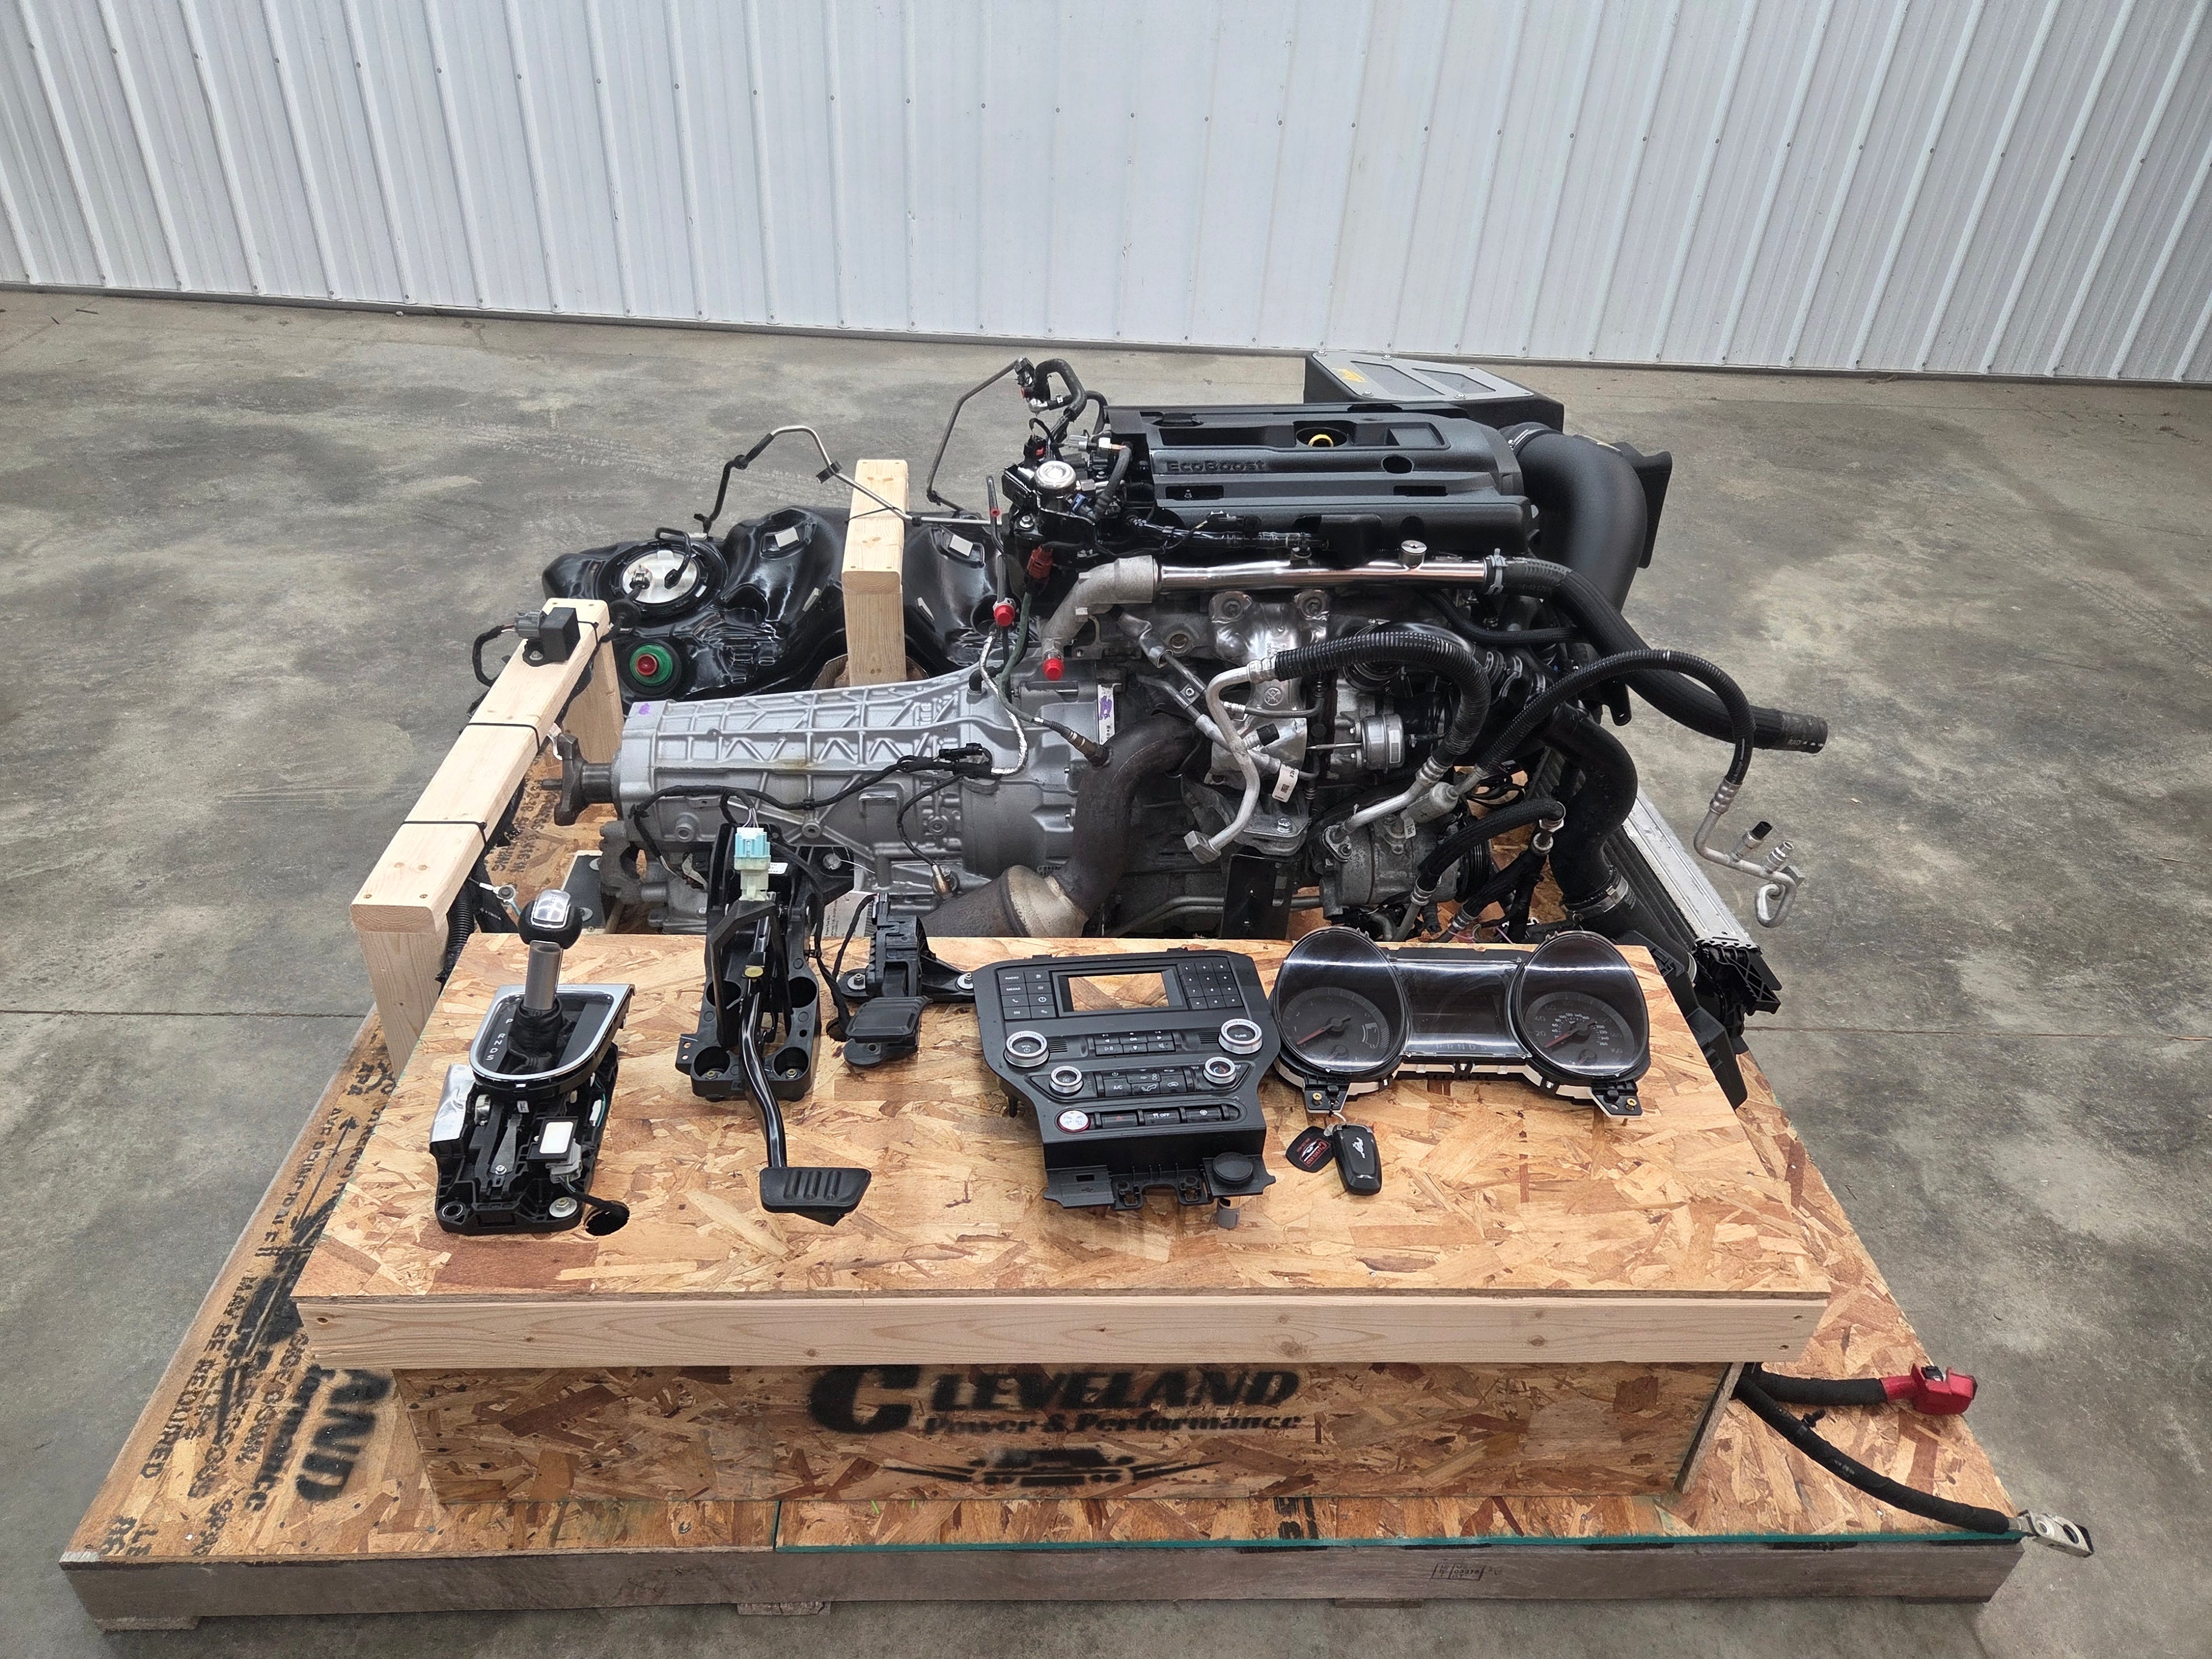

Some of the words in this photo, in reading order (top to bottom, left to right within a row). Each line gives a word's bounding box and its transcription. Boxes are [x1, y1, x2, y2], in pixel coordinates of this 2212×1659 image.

[1166, 460, 1265, 472] EcoBoost
[203, 1323, 234, 1352] BE
[808, 1364, 1303, 1435] CLEVELAND
[140, 1358, 215, 1479] REQUIRED
[925, 1415, 1041, 1435] Power
[1045, 1412, 1066, 1433] &
[1074, 1409, 1303, 1433] Performance
